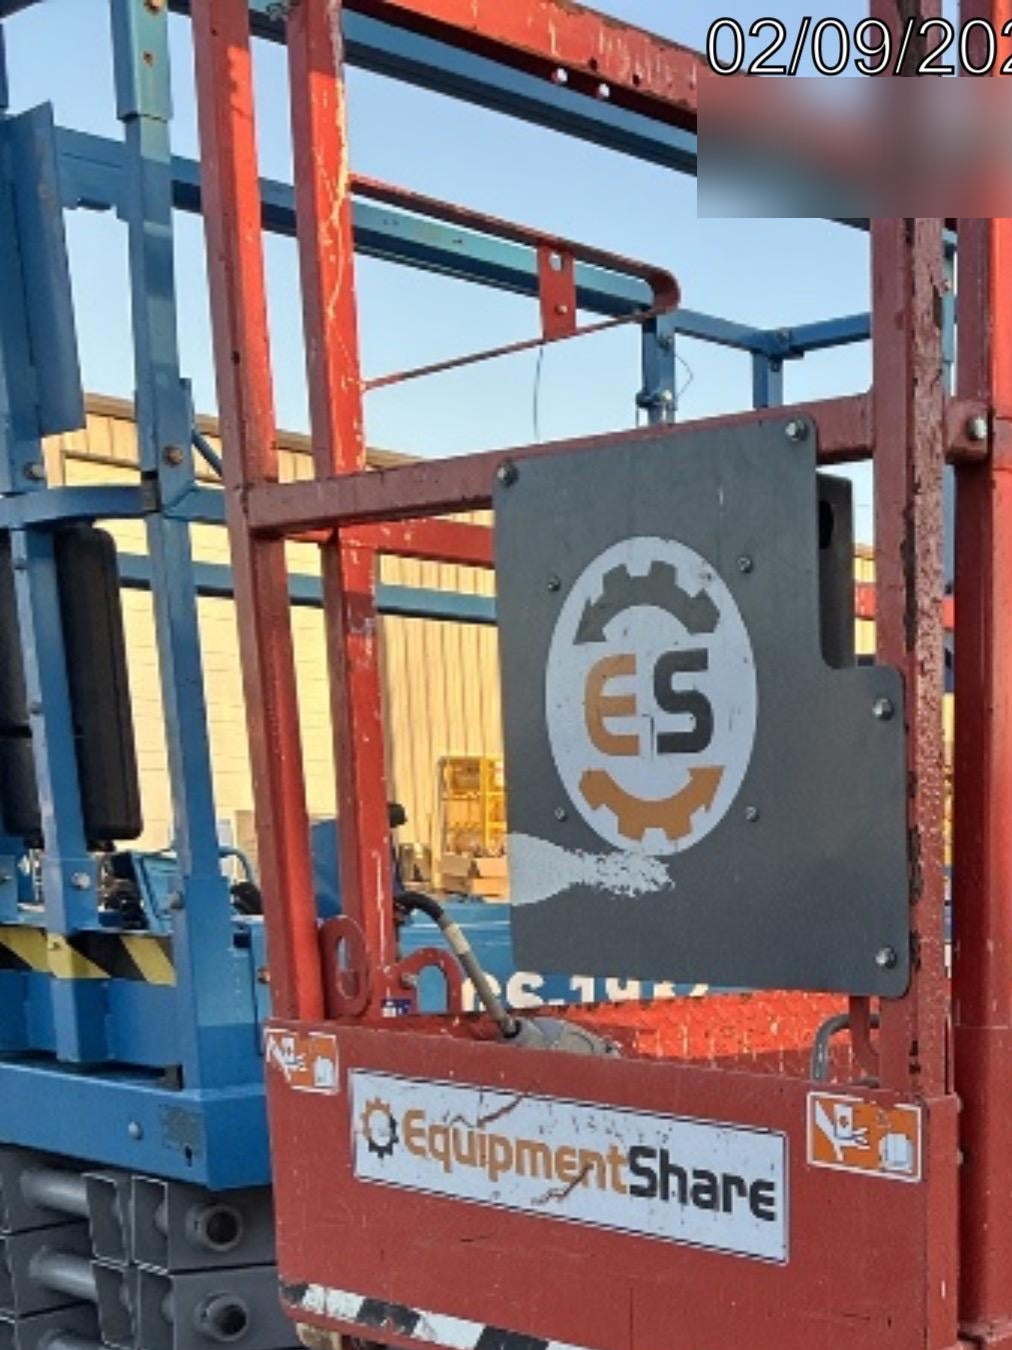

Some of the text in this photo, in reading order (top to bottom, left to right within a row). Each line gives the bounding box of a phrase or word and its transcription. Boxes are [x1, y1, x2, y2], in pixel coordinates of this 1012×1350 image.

[584, 648, 714, 757] ES
[461, 971, 709, 1012] GS-19
[403, 1108, 778, 1222] EquipmentShare
